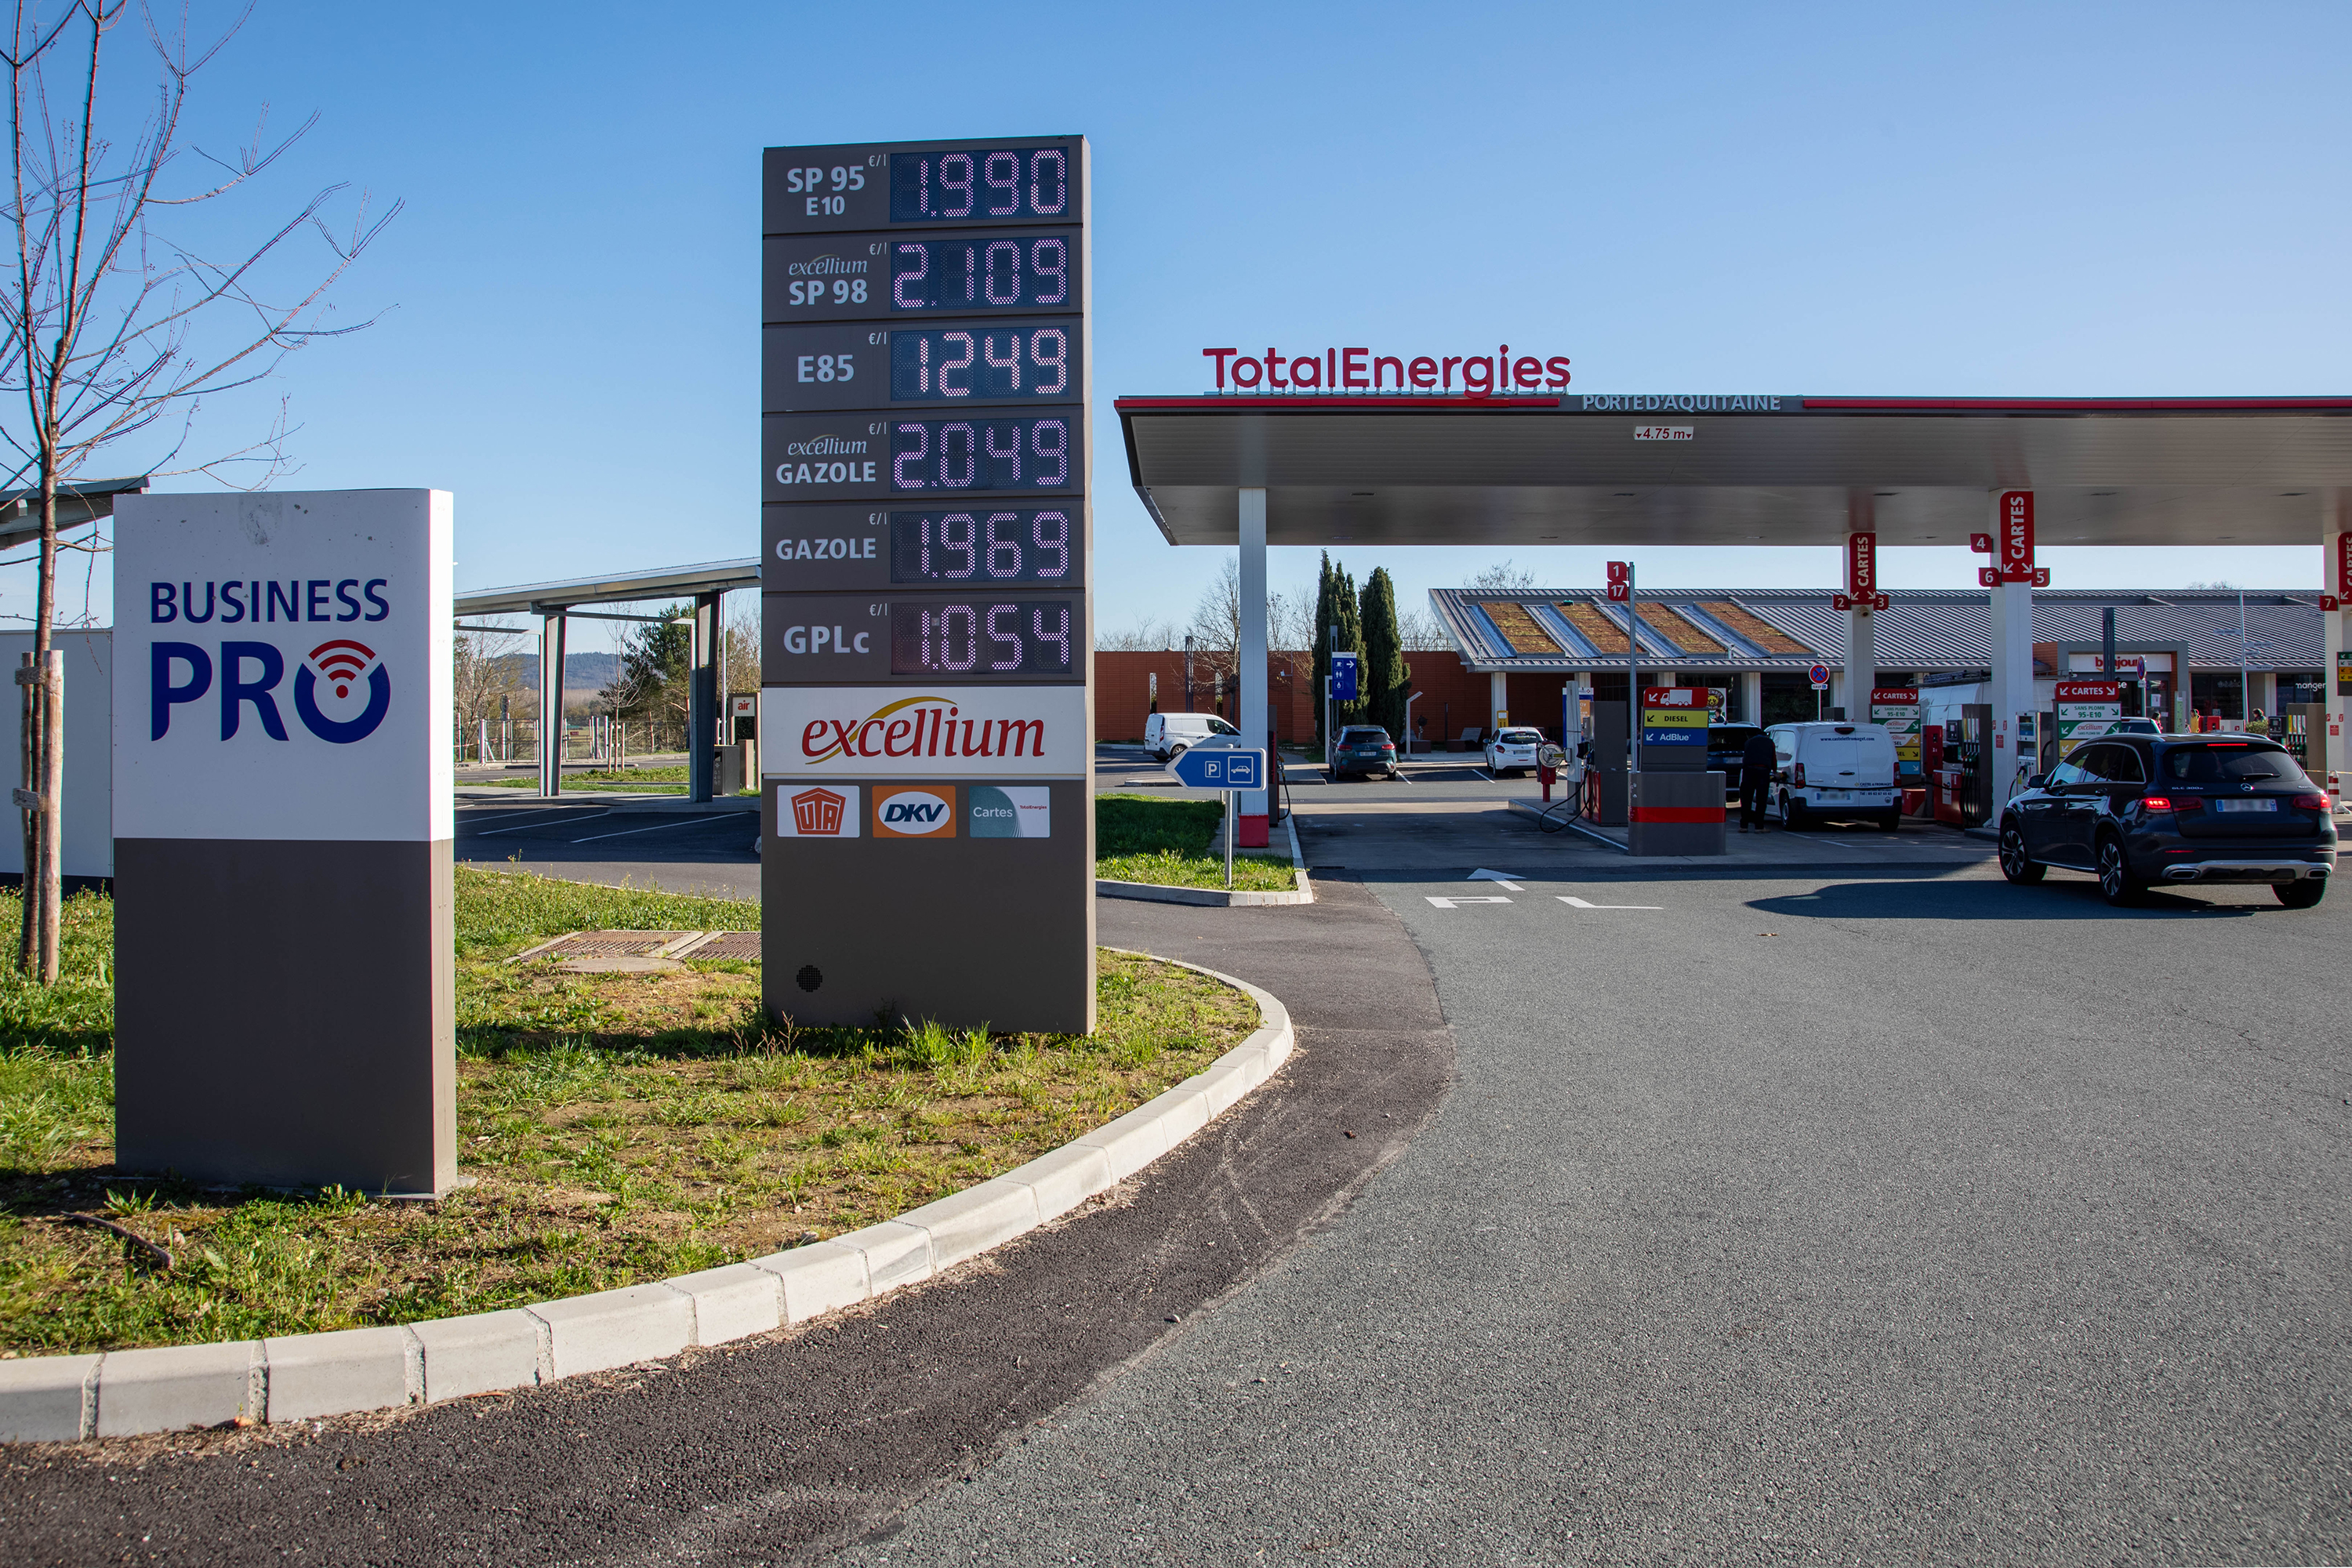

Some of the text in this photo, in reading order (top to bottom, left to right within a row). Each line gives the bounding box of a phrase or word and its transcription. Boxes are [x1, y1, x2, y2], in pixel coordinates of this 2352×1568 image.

[787, 165, 865, 193] SP 95
[920, 150, 1065, 217] 1.990
[806, 195, 844, 216] E10
[789, 256, 868, 278] excellium
[894, 239, 1066, 308] 2.109
[789, 278, 868, 306] SP 98
[797, 354, 855, 383] E85
[1202, 343, 1571, 400] TotalEnergies
[1642, 427, 1685, 439] 4.75 m
[788, 437, 867, 456] excellium
[894, 419, 1067, 488] 2.049
[776, 461, 877, 485] GAZOLE
[2009, 496, 2025, 559] CARTES
[776, 538, 877, 560] GAZOLE
[921, 511, 1068, 579] 1.969
[1976, 537, 1986, 549] 4
[1613, 564, 1619, 577] 1
[1857, 536, 1869, 586] CARTES
[1985, 571, 1994, 583] 6
[2036, 572, 2045, 583] 5
[151, 579, 390, 624] BUSINESS
[1610, 585, 1624, 597] 17
[1837, 597, 1845, 608] 2
[1878, 597, 1884, 607] 3
[2325, 598, 2332, 608] 7
[784, 626, 869, 654] GPLc
[921, 604, 1069, 670] 1.054
[151, 640, 390, 744] PRO
[738, 700, 750, 710] air
[801, 706, 1045, 757] excellium
[1208, 764, 1217, 775] P
[797, 793, 840, 830] UTA
[884, 804, 946, 822] DKV
[973, 806, 1013, 818] Cartes
